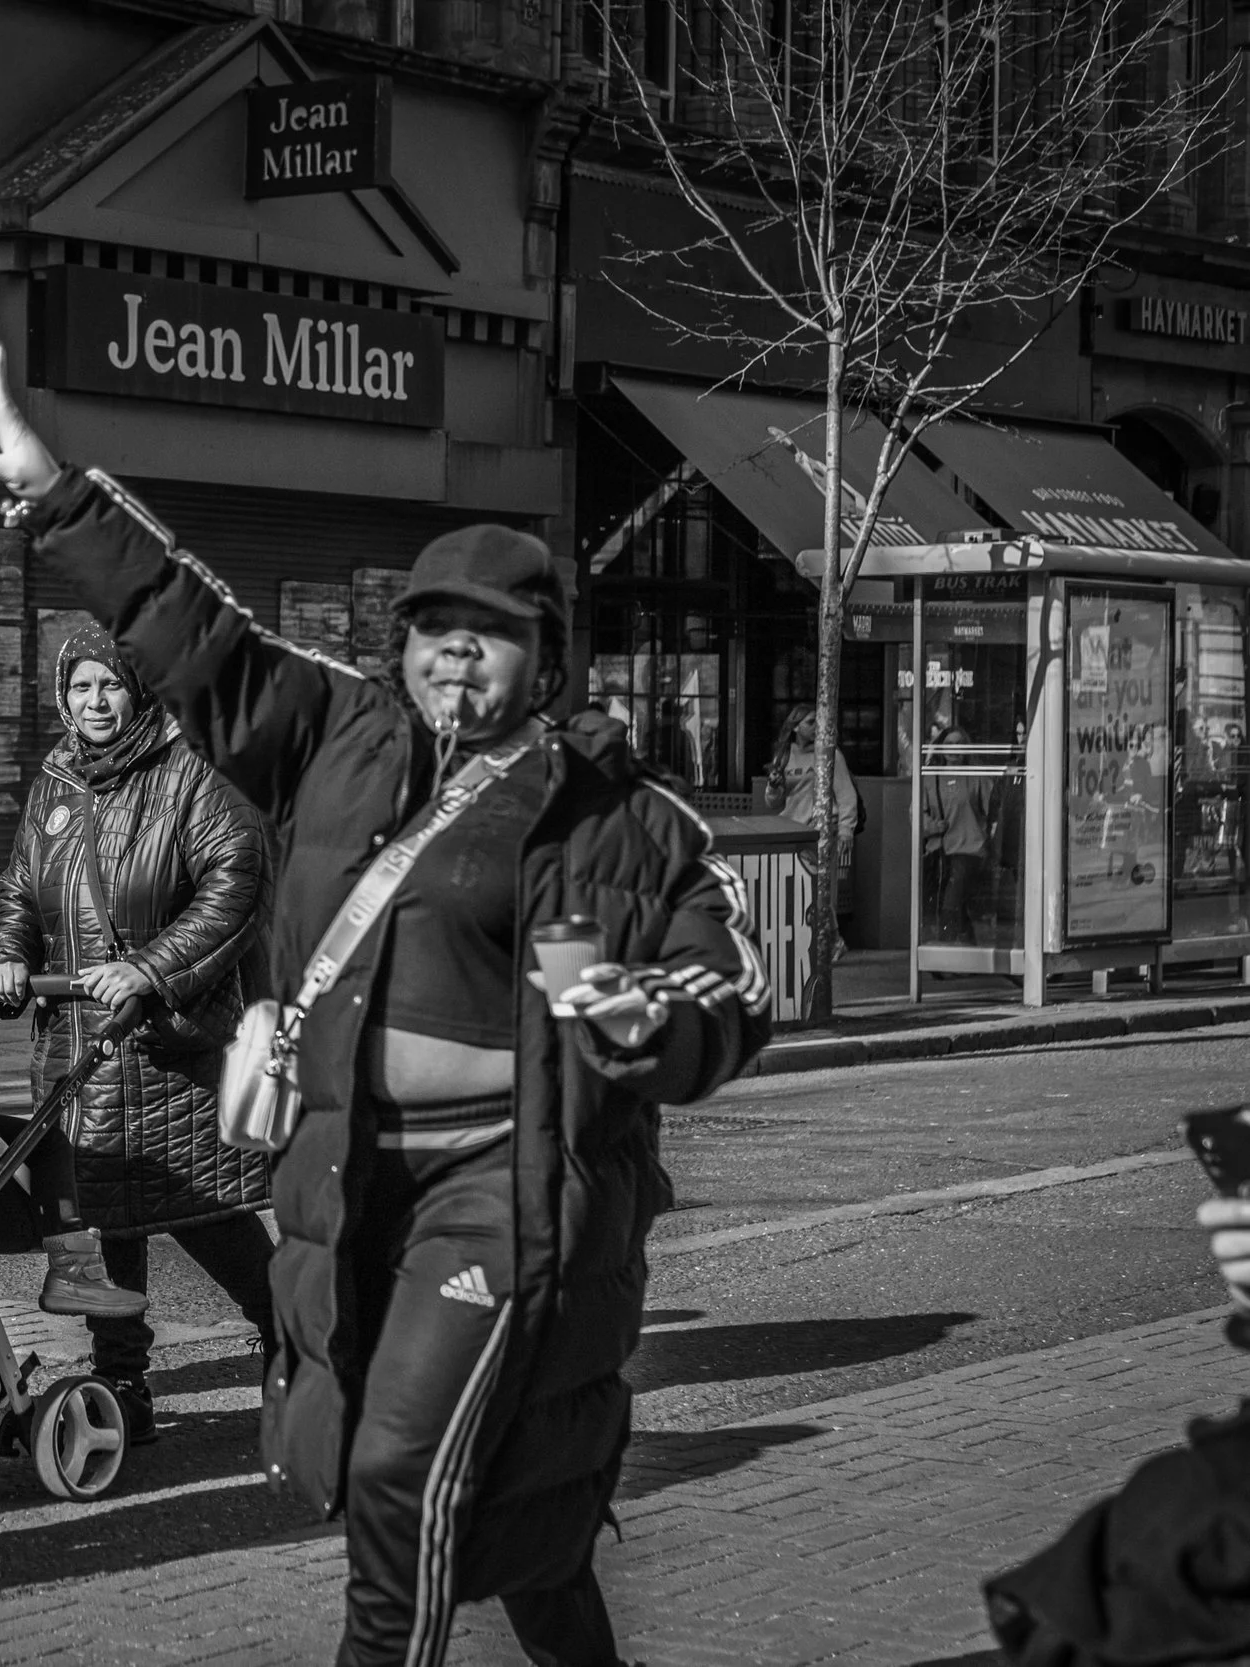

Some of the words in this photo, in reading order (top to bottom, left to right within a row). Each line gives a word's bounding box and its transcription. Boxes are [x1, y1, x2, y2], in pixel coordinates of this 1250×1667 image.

[270, 97, 348, 135] Jean
[263, 143, 358, 181] Millar
[1141, 296, 1248, 345] HAYMARKET
[108, 293, 244, 383] Jean
[264, 312, 415, 401] Millar
[1021, 510, 1199, 552] HAYMARKET
[934, 577, 968, 590] BUS
[974, 575, 1022, 589] TRAK
[1114, 679, 1152, 716] you
[1077, 757, 1120, 797] for?
[439, 1283, 495, 1308] adidas
